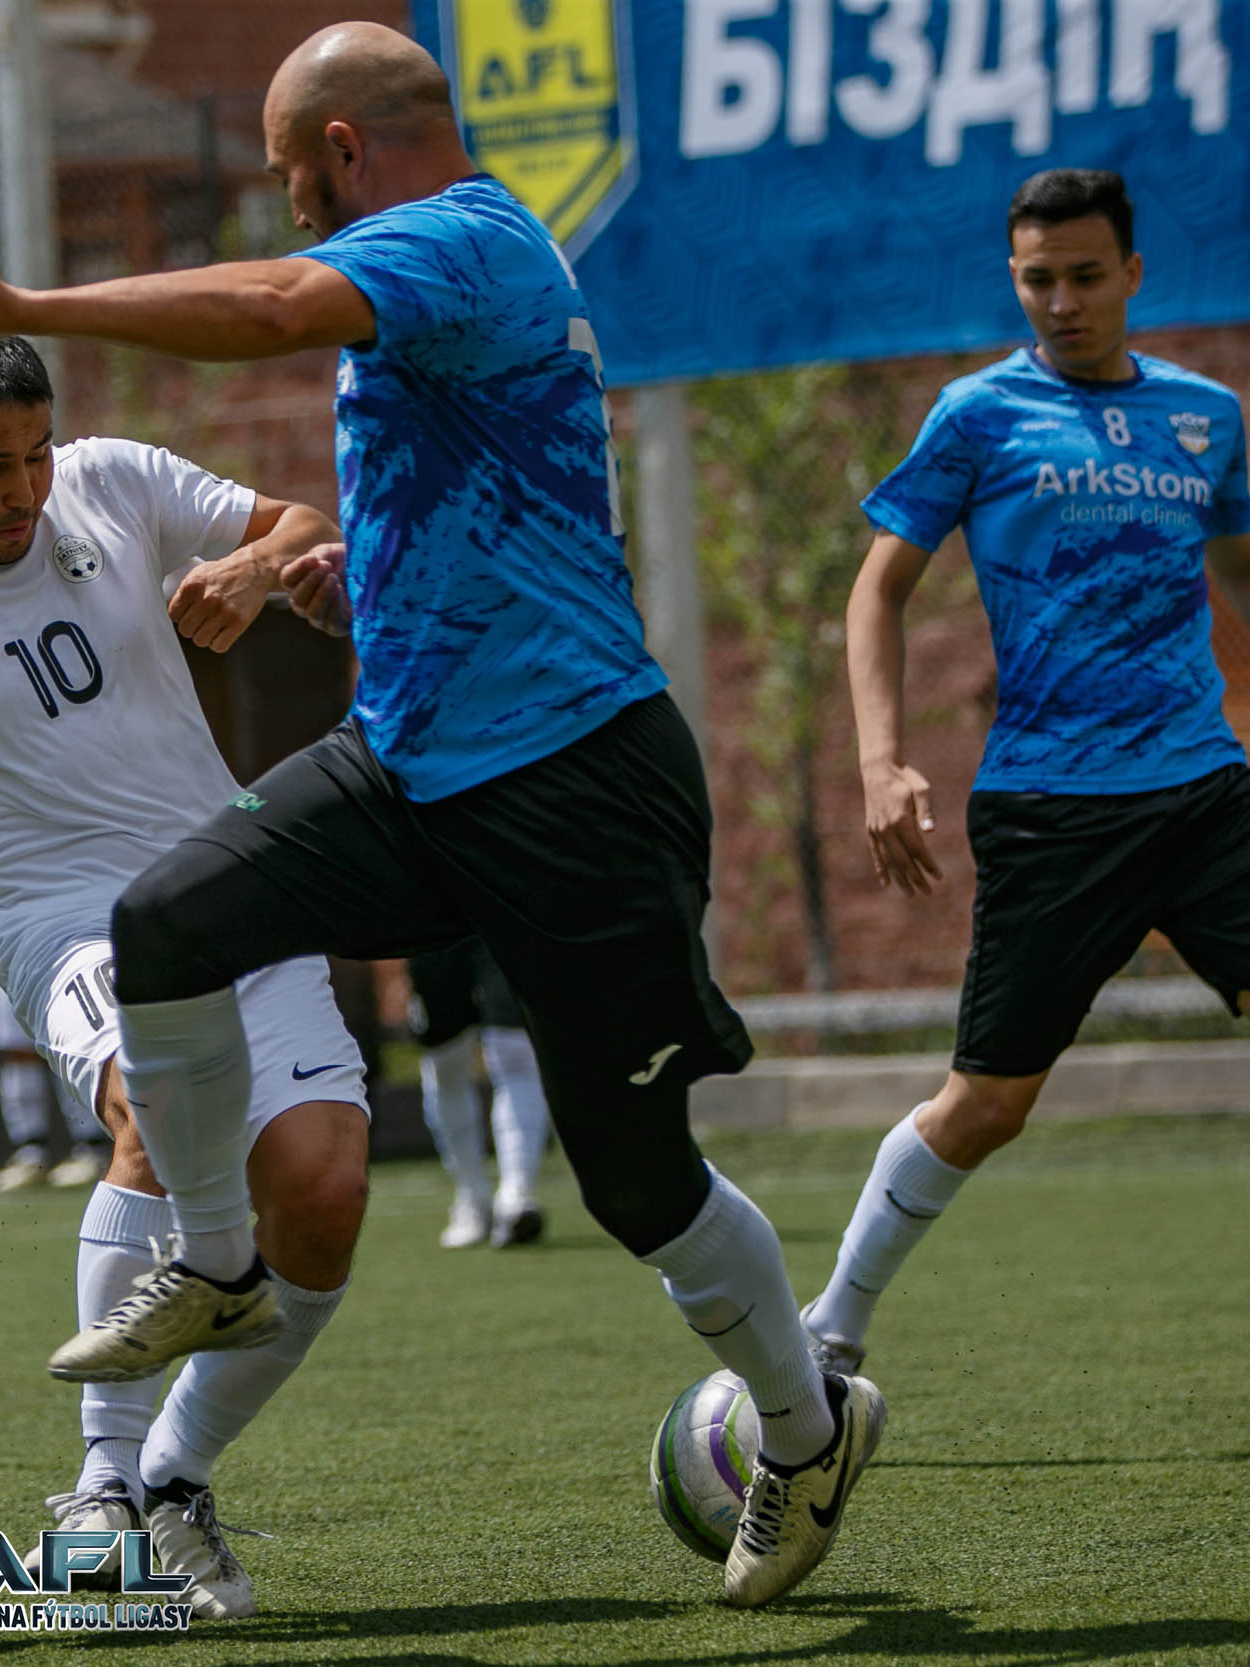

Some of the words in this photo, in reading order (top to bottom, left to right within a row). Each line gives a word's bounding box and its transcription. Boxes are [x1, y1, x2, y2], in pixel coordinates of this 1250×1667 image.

[479, 45, 614, 103] AFL
[1102, 406, 1132, 447] 8
[1033, 457, 1212, 505] ArkStom
[1060, 502, 1134, 524] dental
[1141, 502, 1191, 528] clinic
[4, 620, 103, 719] 10
